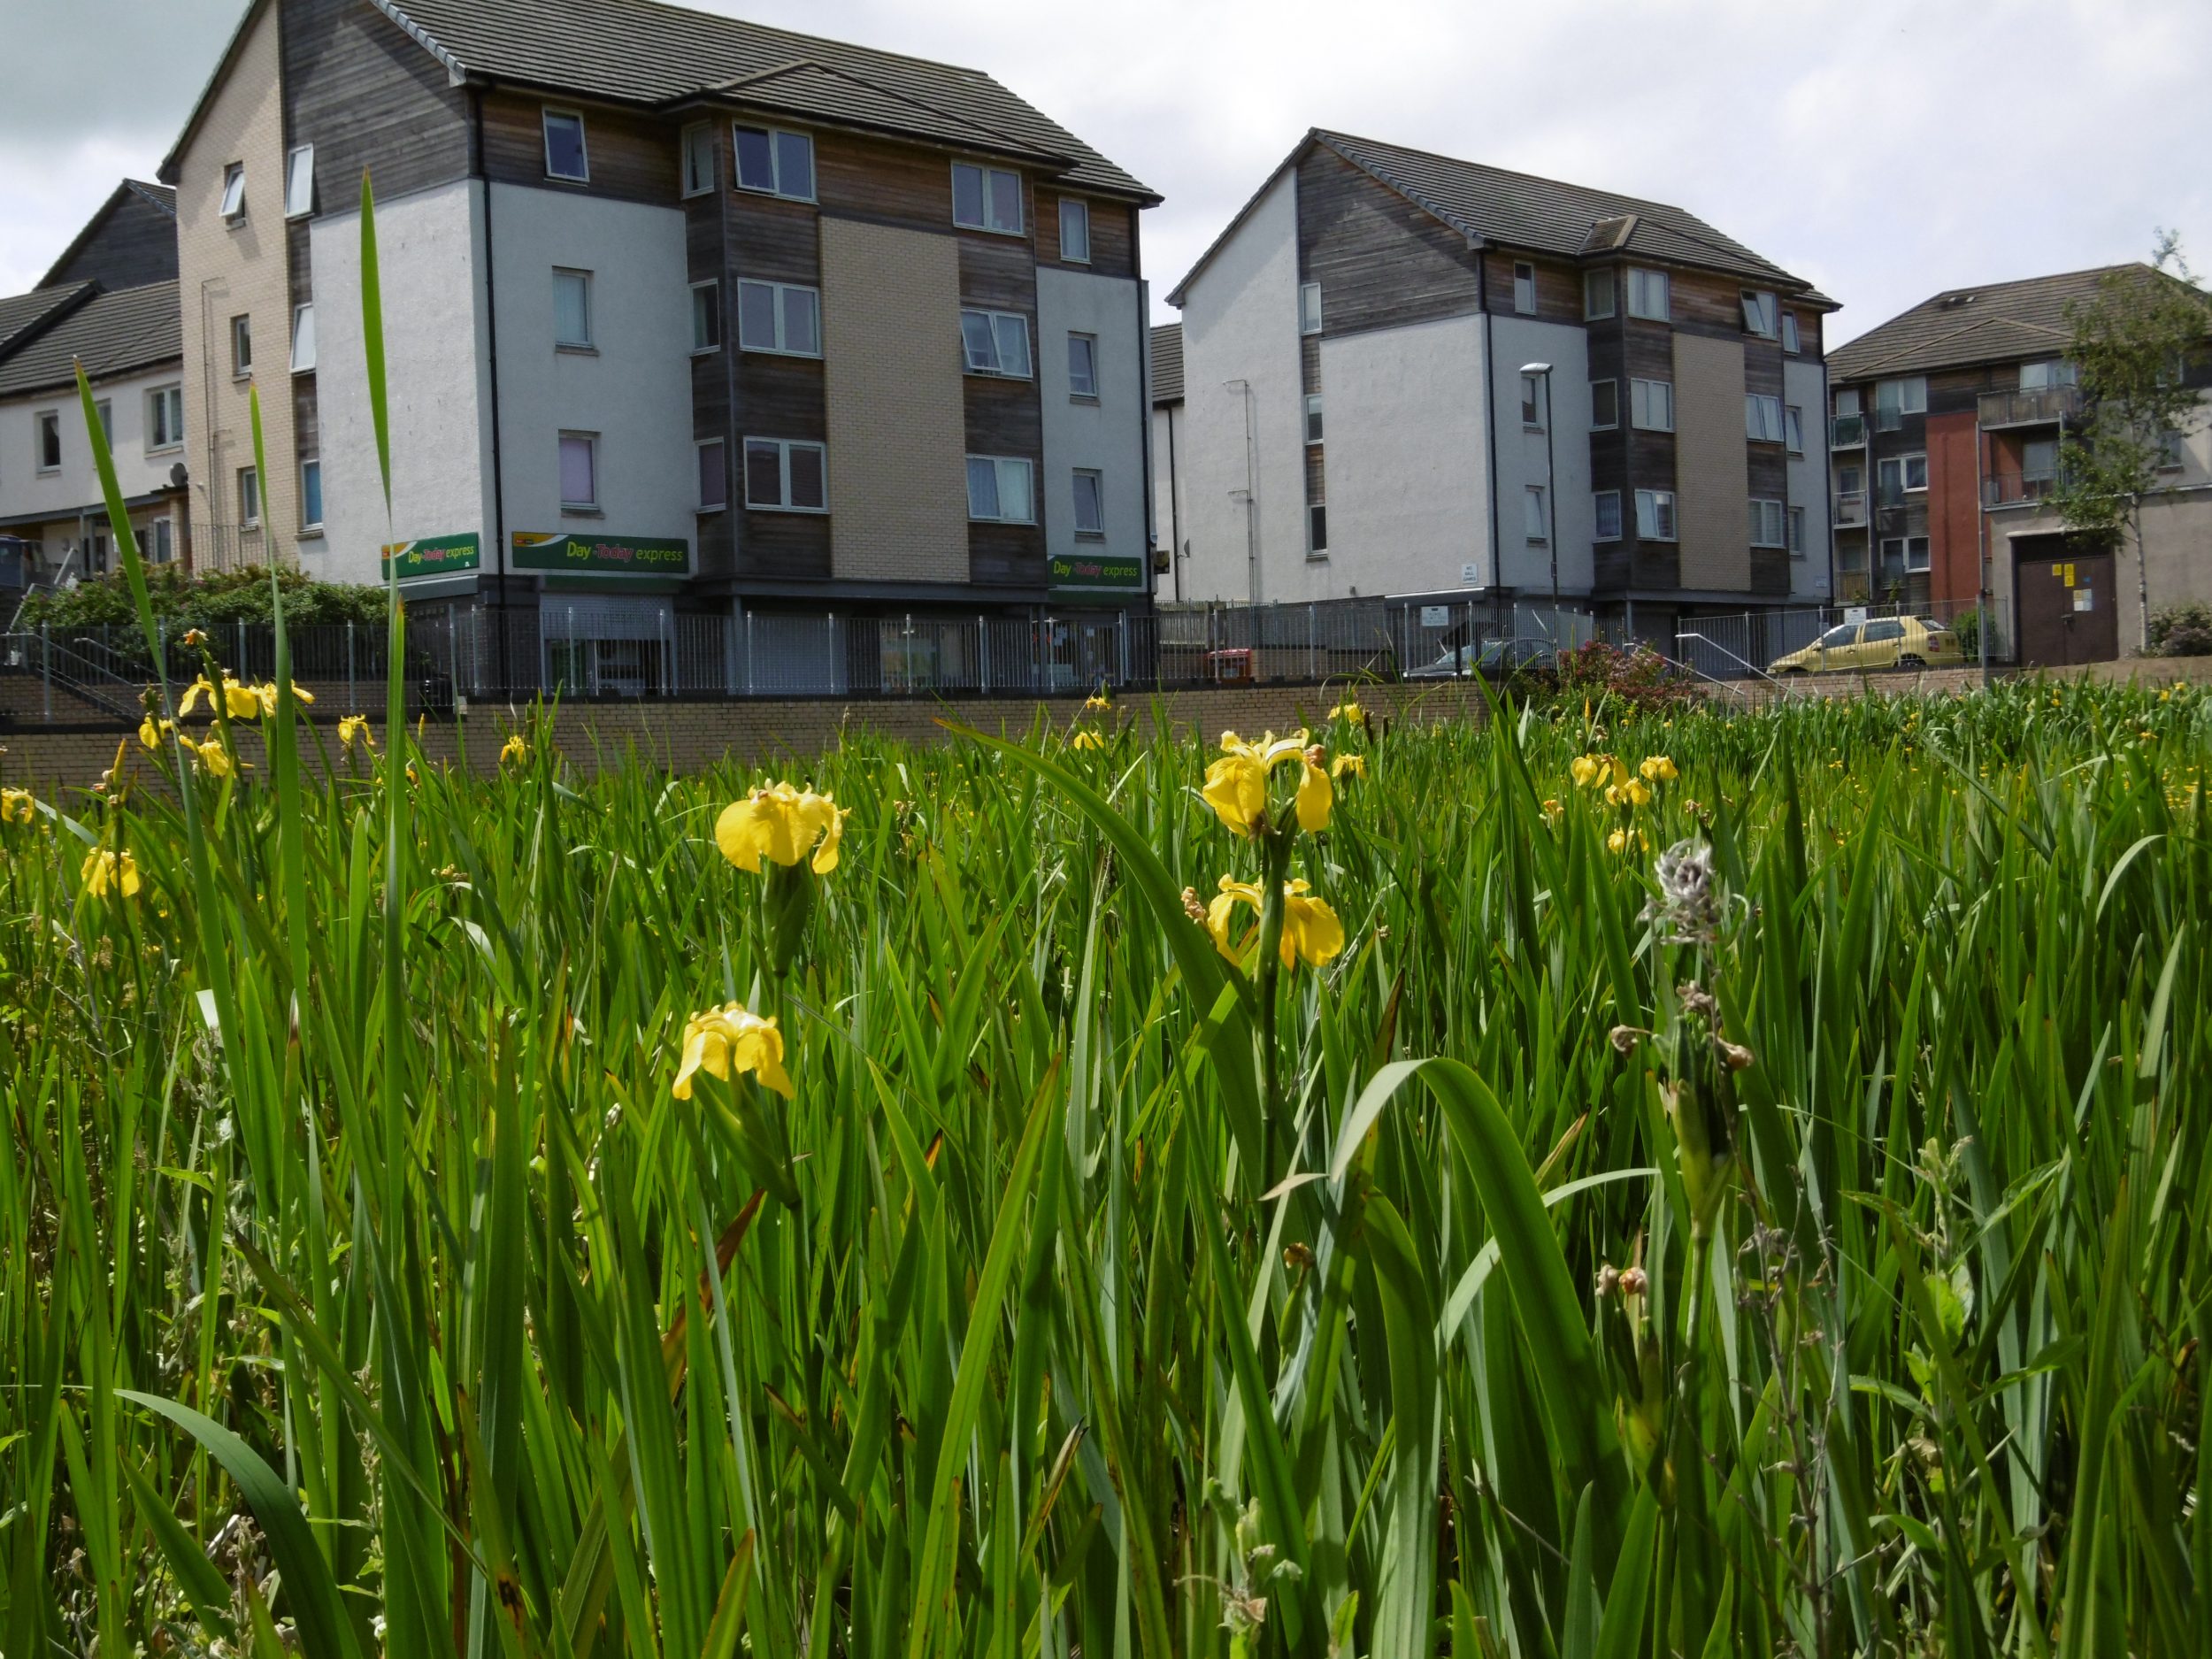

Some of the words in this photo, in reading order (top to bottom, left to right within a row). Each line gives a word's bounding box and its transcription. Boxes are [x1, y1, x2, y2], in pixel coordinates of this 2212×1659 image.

[445, 545, 474, 559] express
[635, 549, 683, 564] express
[1102, 565, 1138, 579] express
